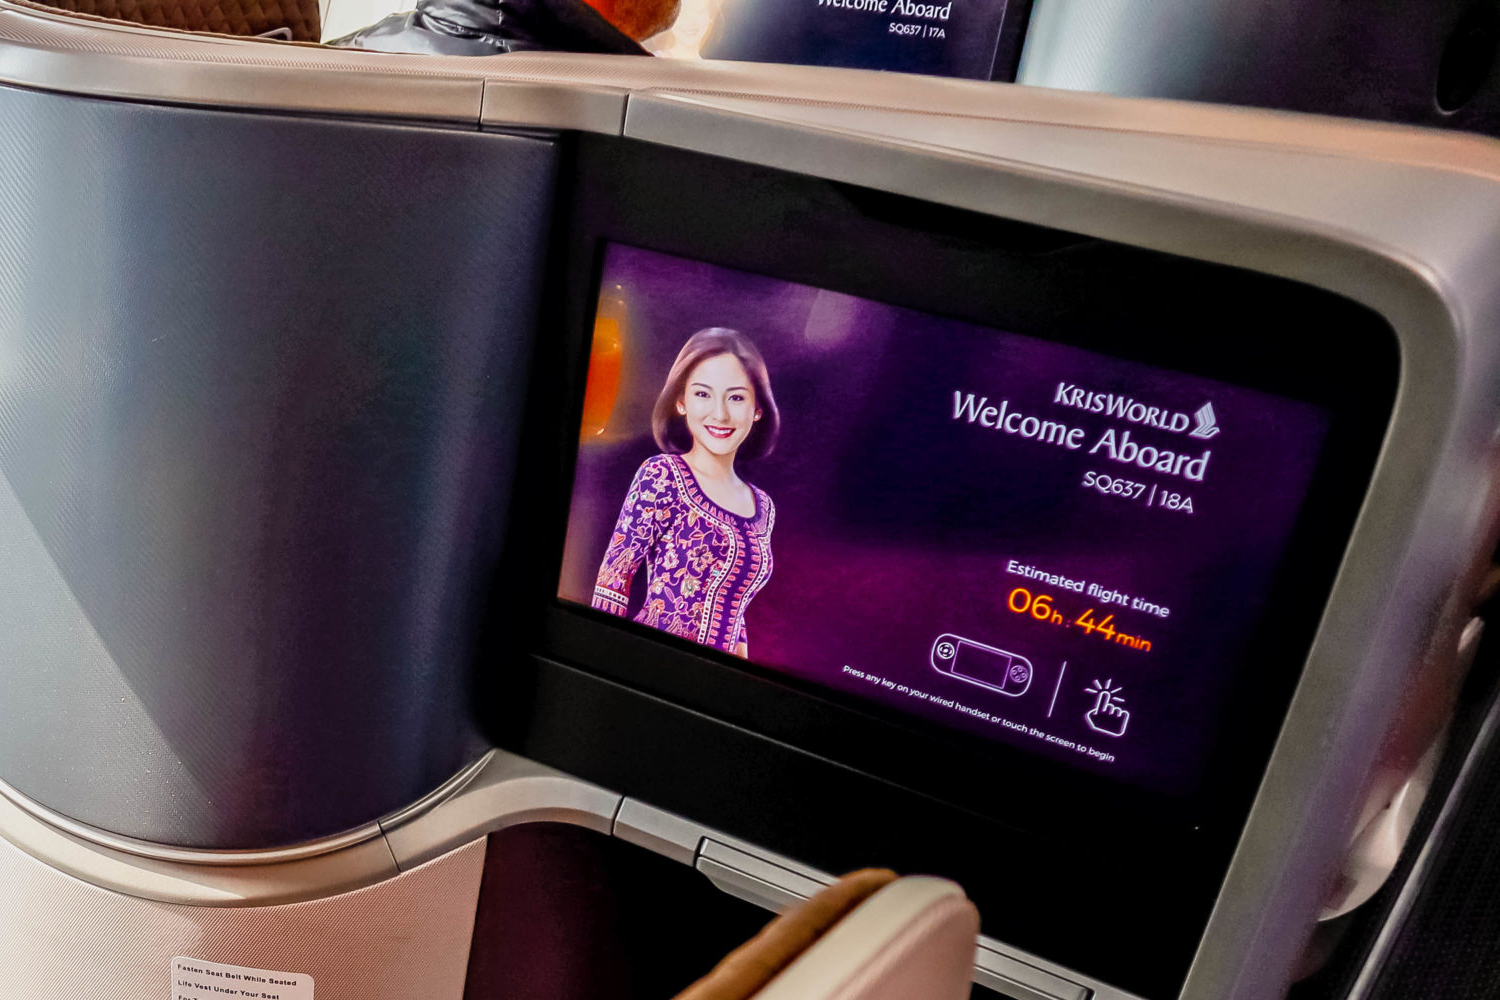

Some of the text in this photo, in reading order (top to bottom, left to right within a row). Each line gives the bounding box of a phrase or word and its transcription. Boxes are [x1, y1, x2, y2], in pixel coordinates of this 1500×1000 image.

[888, 22, 921, 35] SQ637
[929, 27, 946, 38] 17A
[891, 0, 952, 20] Aboard
[1054, 382, 1190, 433] KRISWORLD
[952, 390, 1211, 482] Welcome Aboard
[1082, 471, 1146, 500] SQ637
[1159, 490, 1194, 514] 18A
[1006, 559, 1170, 618] Estimated flight time
[843, 664, 1115, 763] Press any key on your wired handset or touch the screen to begin
[177, 963, 297, 987] Fasten Seat Belt While Seated
[177, 980, 280, 1000] Life Vest Under Your Seat
